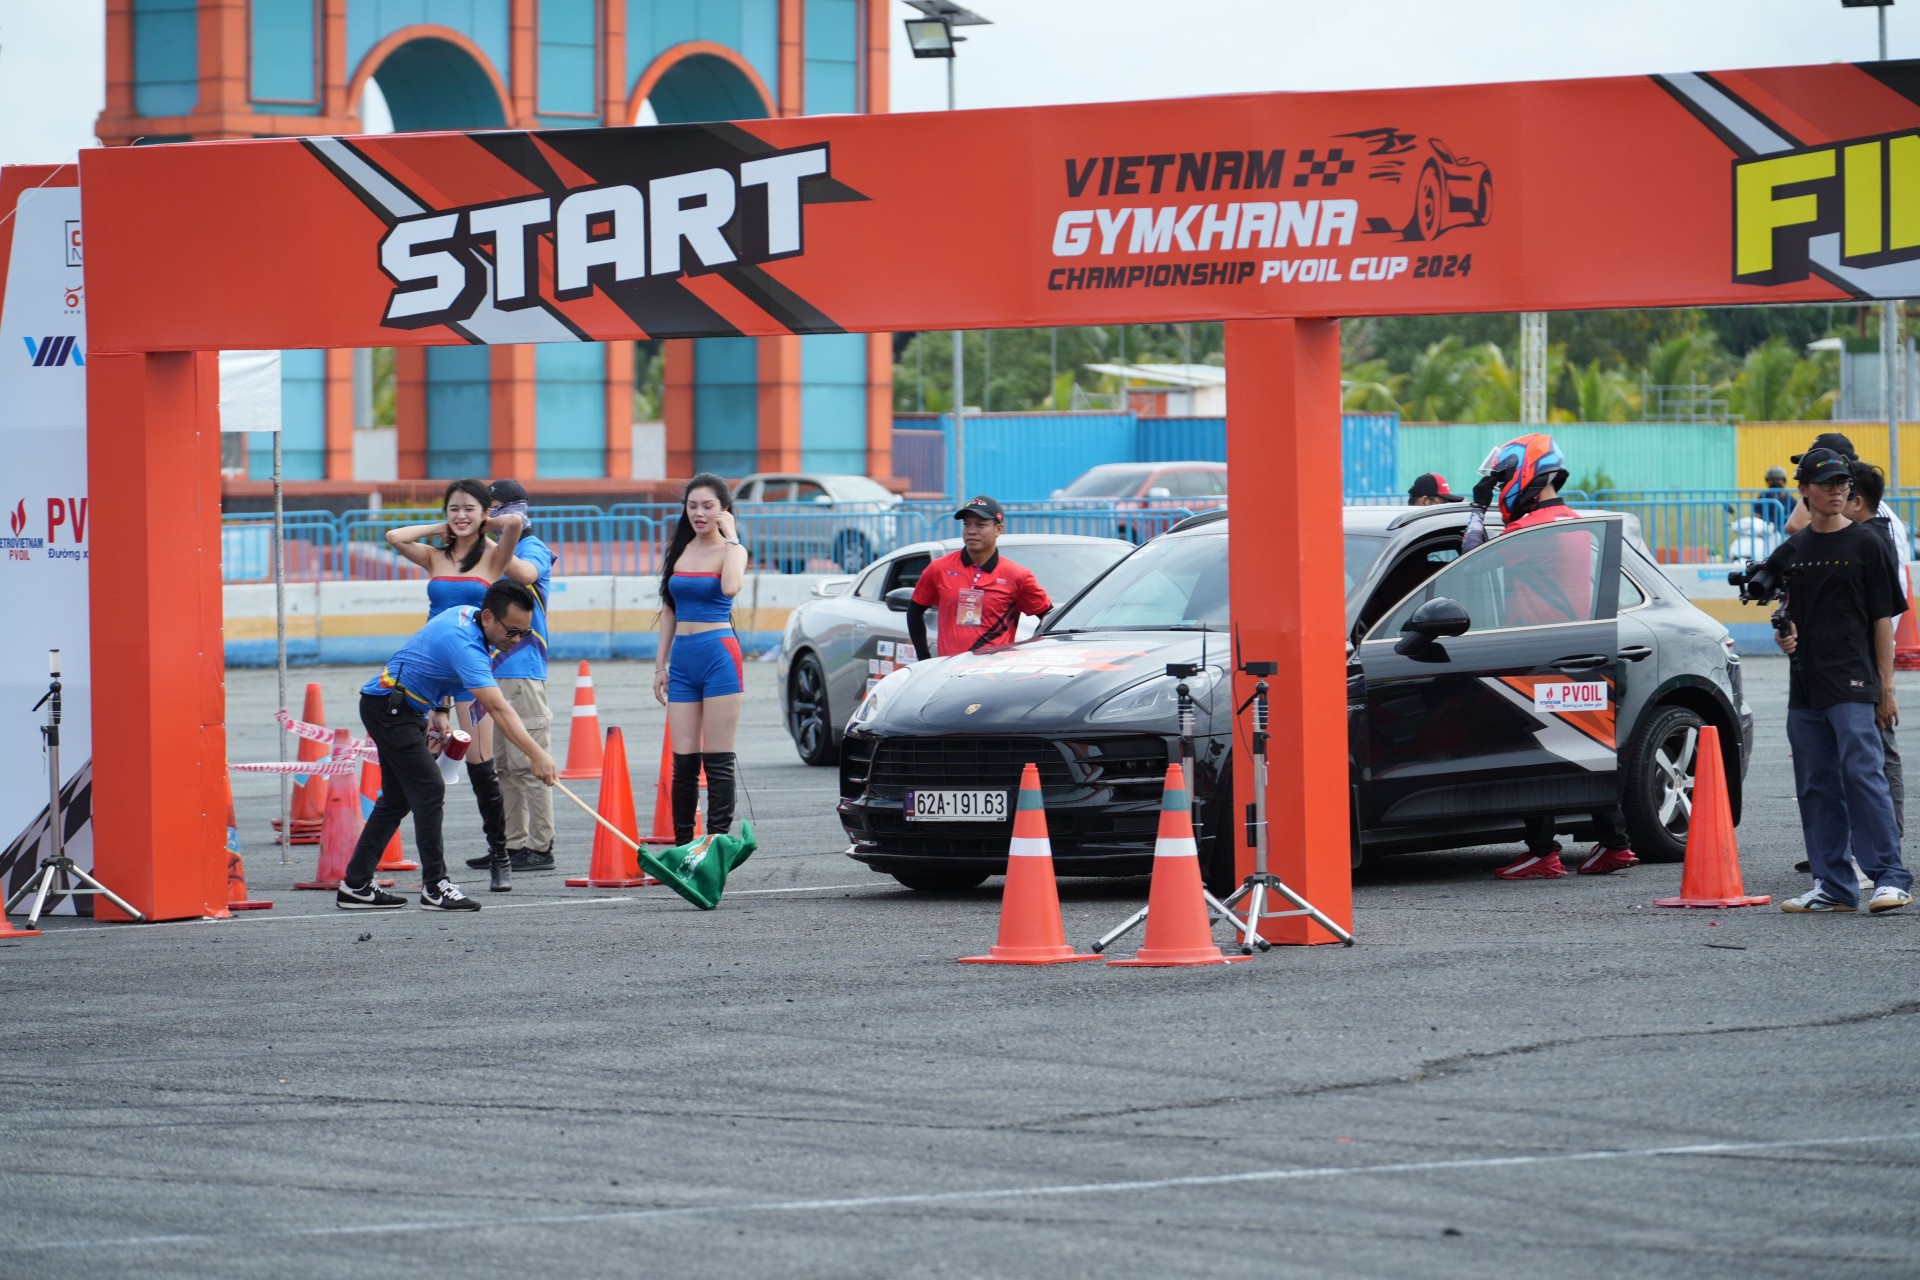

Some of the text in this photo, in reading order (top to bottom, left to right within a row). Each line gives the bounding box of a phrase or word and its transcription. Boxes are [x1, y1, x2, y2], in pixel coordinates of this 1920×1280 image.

[1065, 149, 1286, 198] VIETNAM
[381, 148, 827, 319] START
[1052, 199, 1359, 257] GYMKHANA
[1047, 254, 1473, 291] CHAMPIONSHIP PVOIL CUP 2024
[1562, 685, 1602, 703] PVOIL
